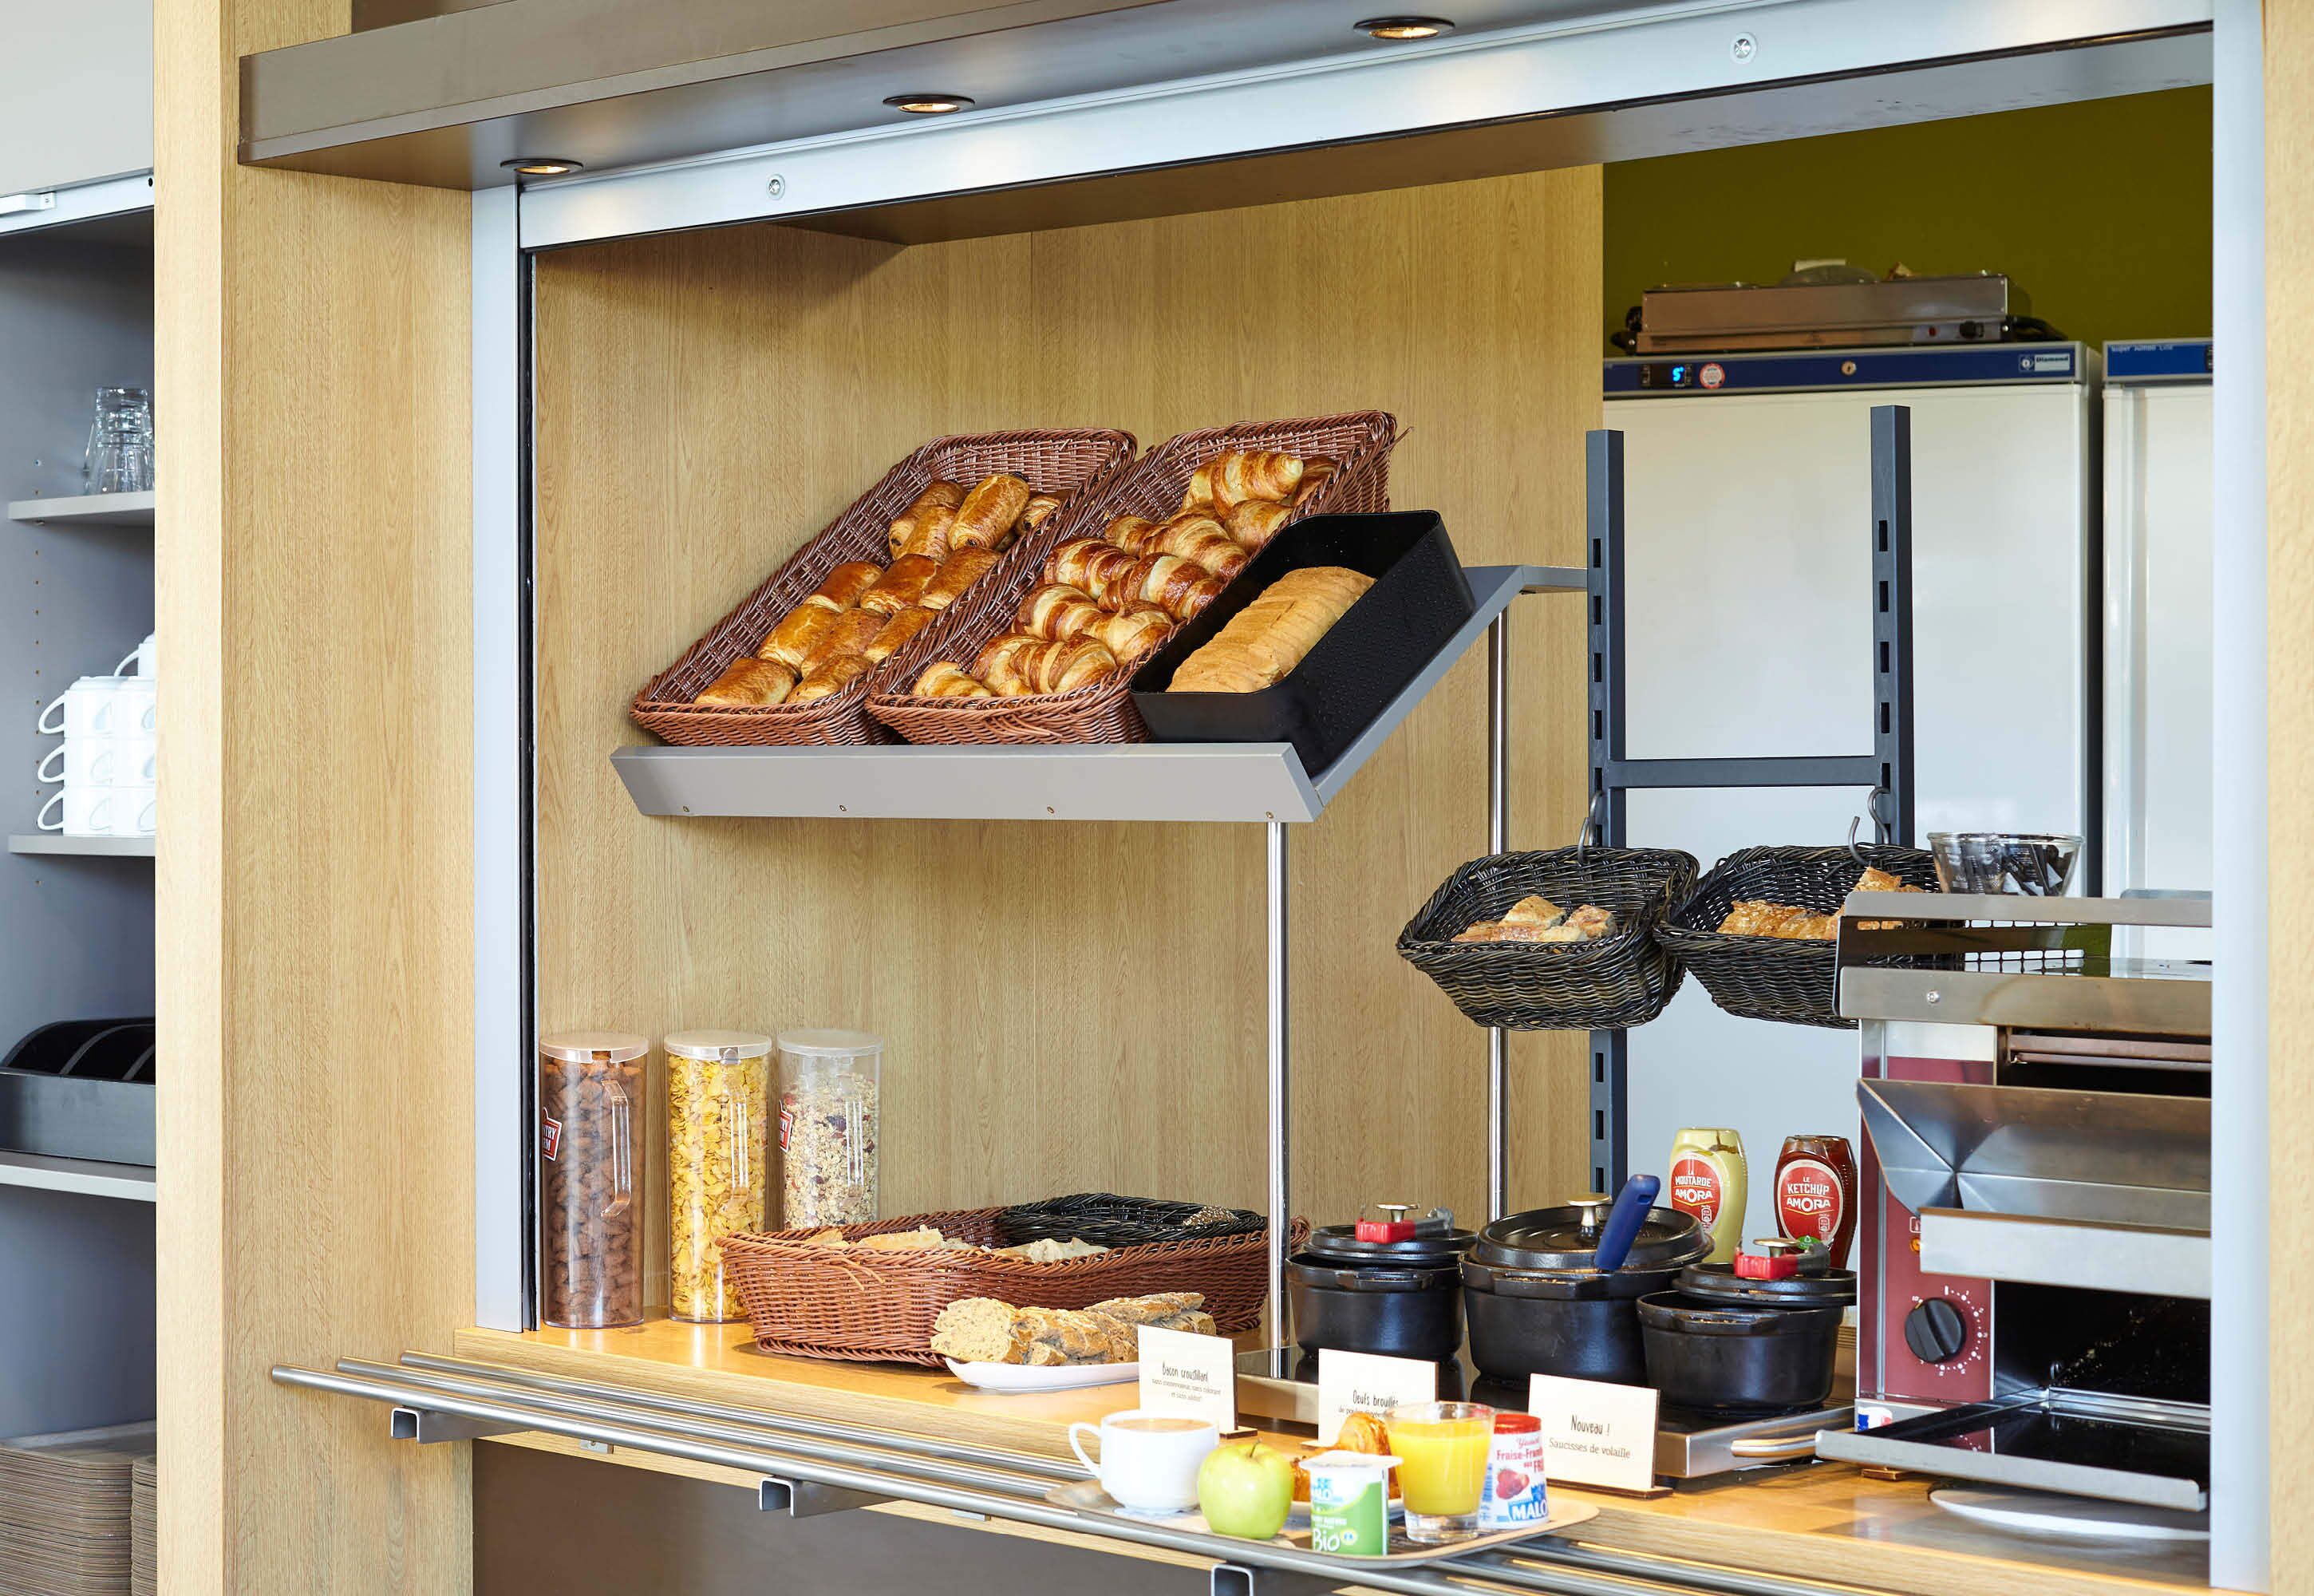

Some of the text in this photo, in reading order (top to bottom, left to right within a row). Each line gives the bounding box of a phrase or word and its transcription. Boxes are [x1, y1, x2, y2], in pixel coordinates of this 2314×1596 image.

[1675, 1175, 1712, 1187] MOUTARDE
[1787, 1183, 1830, 1195] KETCHUP
[1675, 1188, 1713, 1203] AMORA
[1787, 1197, 1831, 1212] AMORA
[1352, 1389, 1370, 1406] Oeufs
[1570, 1414, 1603, 1435] Nouveau
[1549, 1437, 1631, 1459] Saucisses de volaille
[1510, 1499, 1548, 1521] MALO
[1312, 1527, 1341, 1552] Bio
